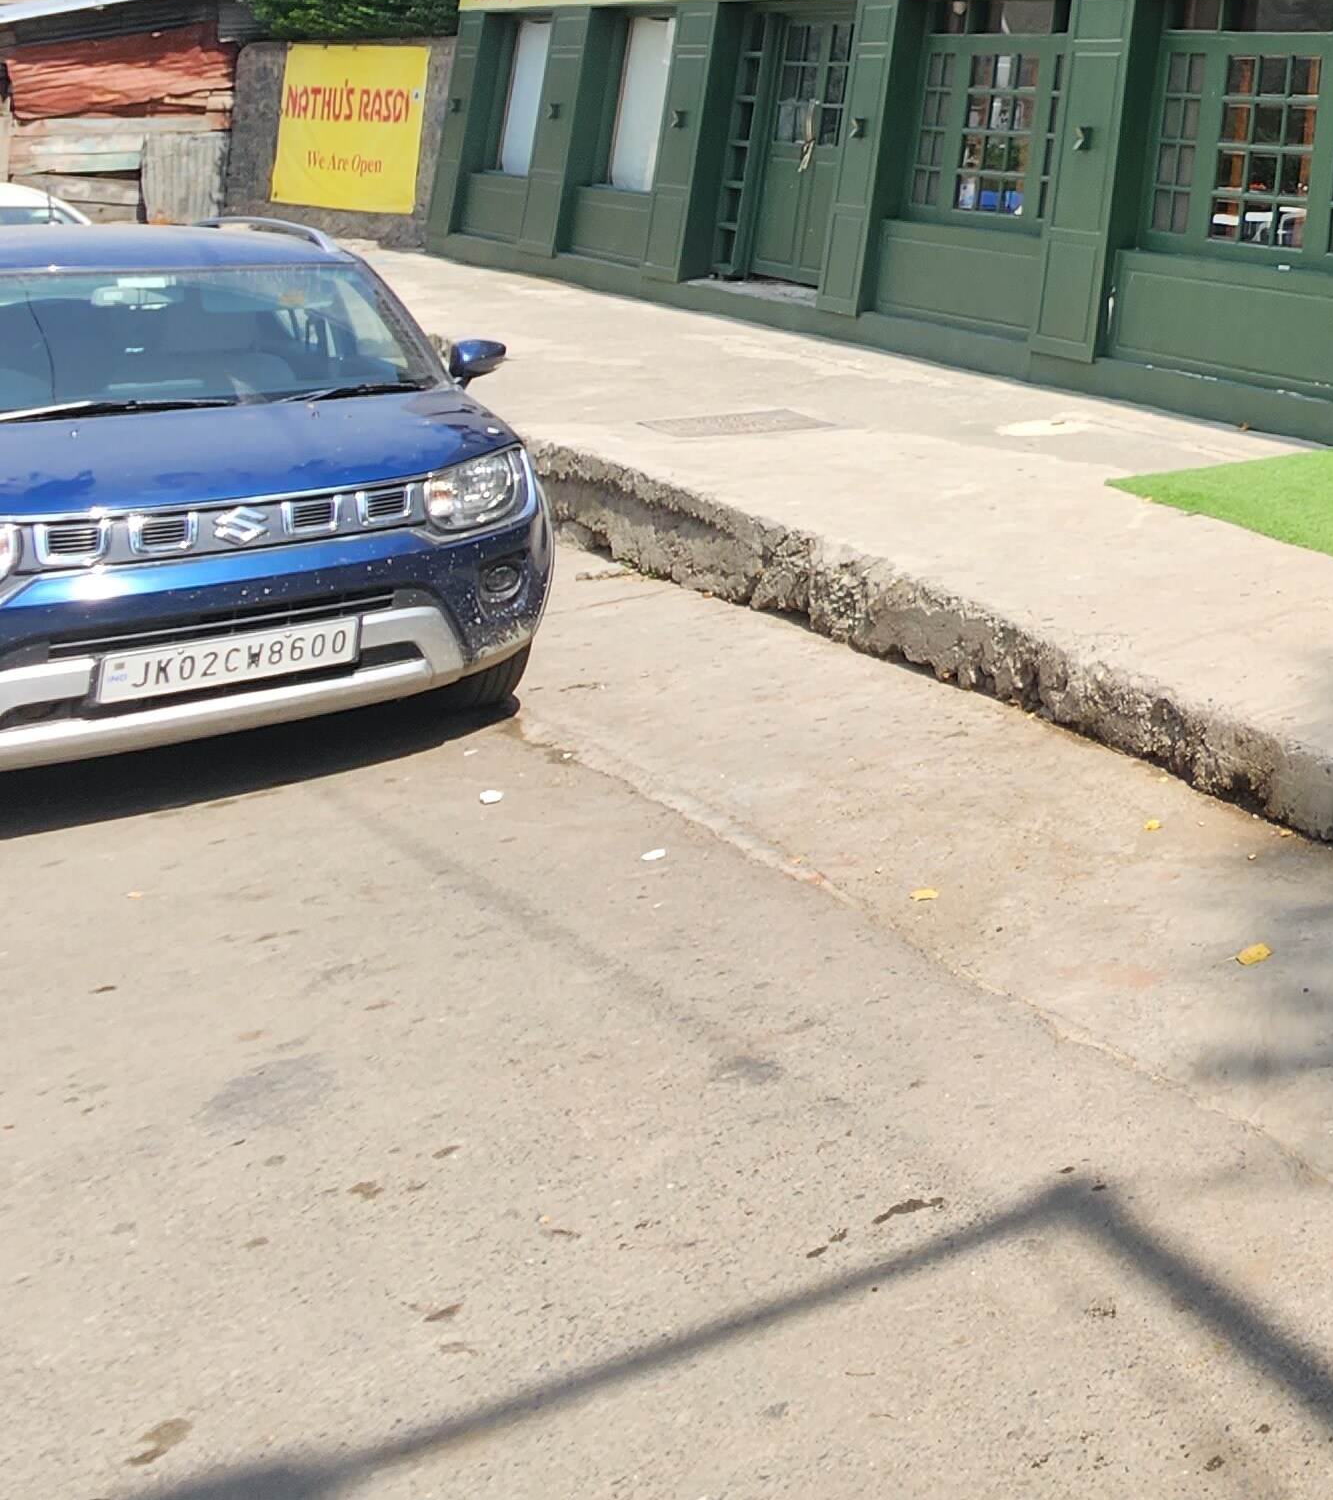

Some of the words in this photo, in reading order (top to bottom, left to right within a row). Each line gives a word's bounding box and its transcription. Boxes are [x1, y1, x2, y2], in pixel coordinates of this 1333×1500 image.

[285, 78, 355, 122] NATHU'S
[358, 88, 410, 123] RASOI
[308, 150, 325, 170] We
[327, 152, 349, 172] Are
[351, 154, 382, 177] Open
[131, 629, 346, 688] JK02CW8600
